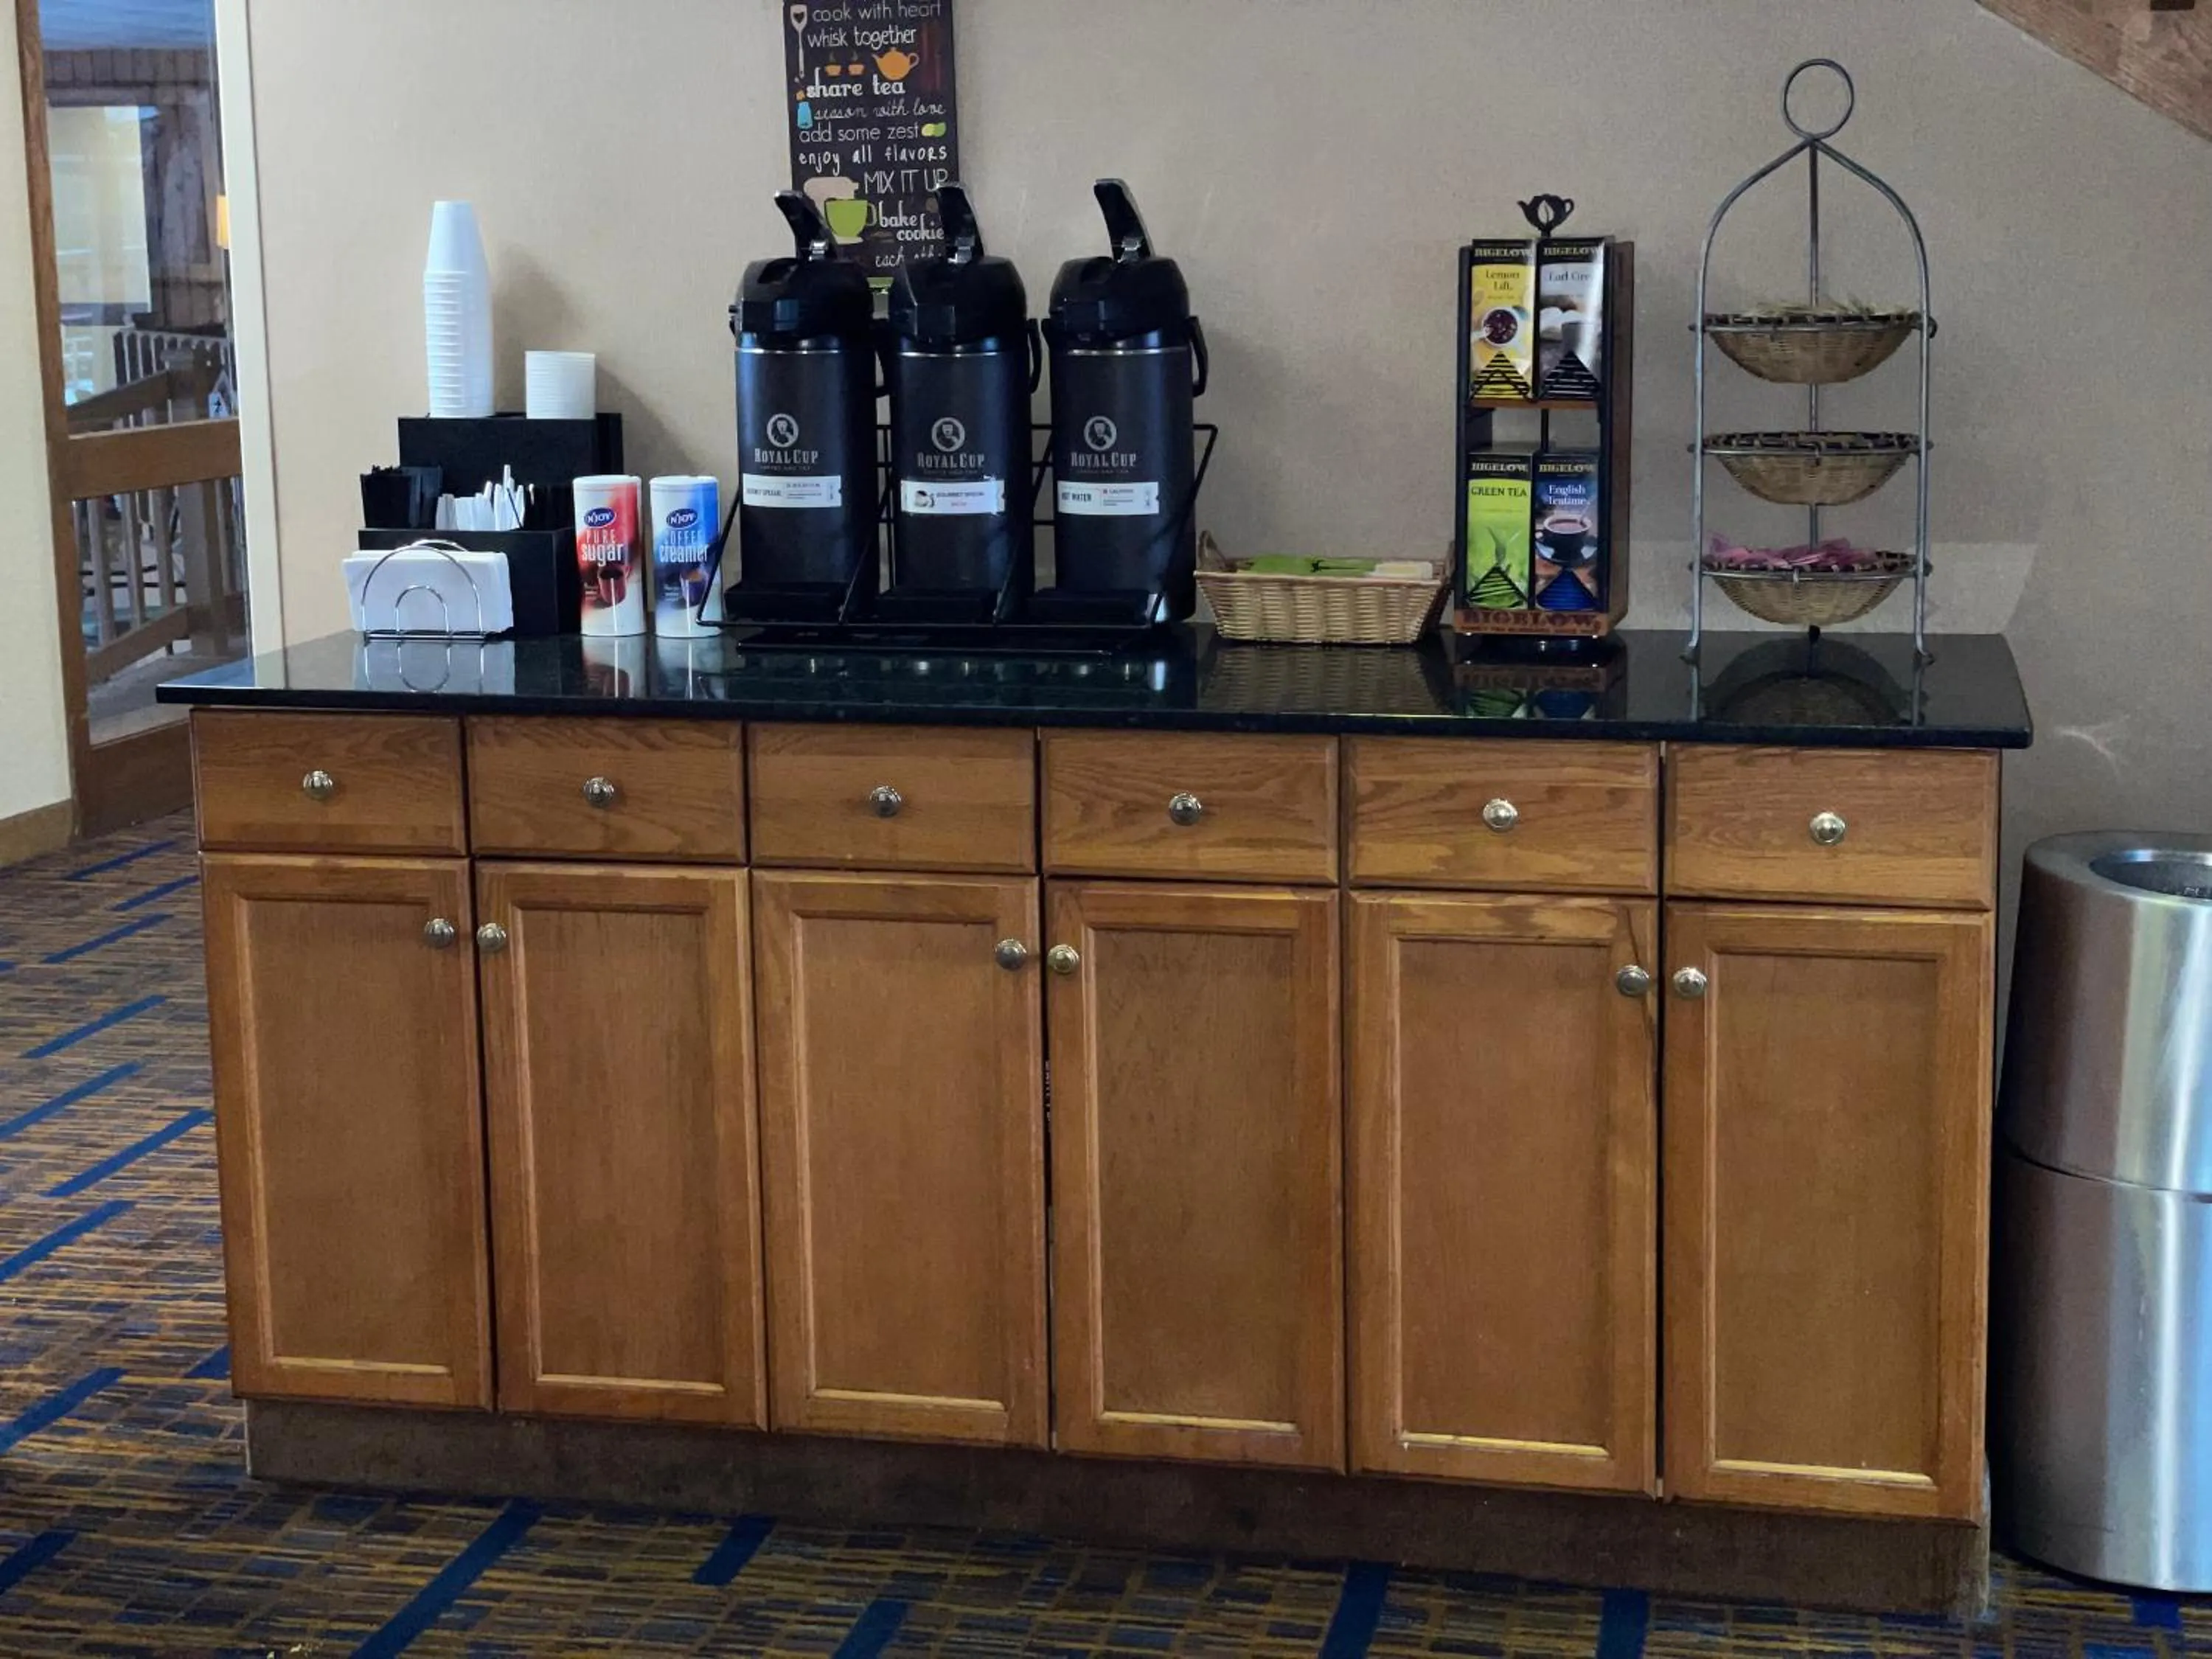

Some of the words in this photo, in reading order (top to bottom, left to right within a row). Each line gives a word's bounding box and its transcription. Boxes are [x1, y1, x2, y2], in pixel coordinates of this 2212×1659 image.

[813, 3, 851, 21] cook
[858, 3, 891, 19] with
[898, 1, 942, 17] heart
[807, 27, 847, 48] whisk
[854, 24, 917, 49] together
[806, 67, 863, 98] share
[873, 74, 905, 95] tea
[873, 100, 908, 117] with
[914, 98, 946, 115] love
[799, 122, 832, 142] add
[838, 128, 881, 142] some
[887, 122, 919, 139] zest
[799, 151, 840, 175] enjoy
[852, 145, 872, 164] all
[864, 170, 895, 194] MIX
[900, 169, 920, 192] IT
[924, 168, 948, 192] UP
[878, 201, 917, 227] bake
[897, 214, 945, 240] cookie
[1475, 247, 1532, 257] BIGELOW
[1486, 270, 1520, 279] Lemon
[1571, 272, 1591, 282] Gre
[1472, 462, 1527, 473] BIGELOW
[1539, 464, 1595, 473] BIGELOW
[1471, 487, 1505, 496] GREEN
[1507, 487, 1528, 497] TEA
[1549, 484, 1585, 496] English
[586, 529, 616, 543] PURE
[581, 543, 624, 567] sugar
[660, 545, 709, 563] creamer
